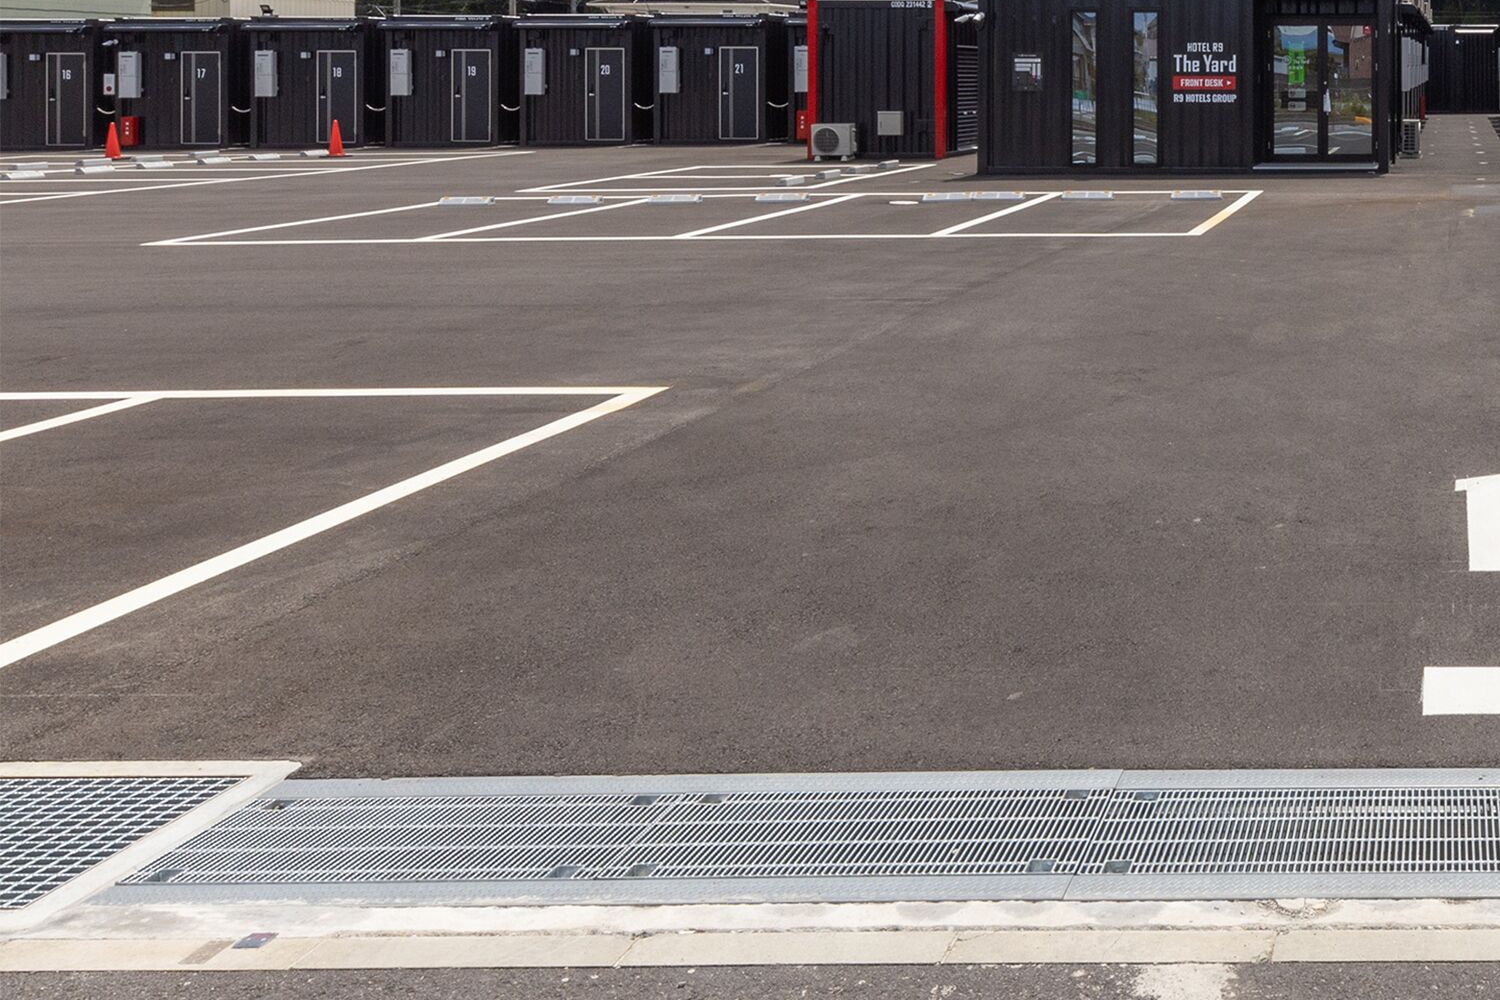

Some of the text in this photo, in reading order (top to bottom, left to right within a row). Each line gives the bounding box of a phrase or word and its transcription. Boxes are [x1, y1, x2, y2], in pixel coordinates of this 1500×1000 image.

[1187, 42, 1224, 52] HOTEL R9
[734, 63, 744, 74] 21
[1173, 54, 1237, 72] The Yard
[62, 69, 72, 80] 16
[197, 68, 206, 79] 17
[332, 67, 342, 78] 18
[467, 66, 477, 76] 19
[600, 64, 611, 75] 20
[1180, 78, 1224, 87] FRONT DESK
[1173, 94, 1237, 103] R9 HOTELS GROUP
